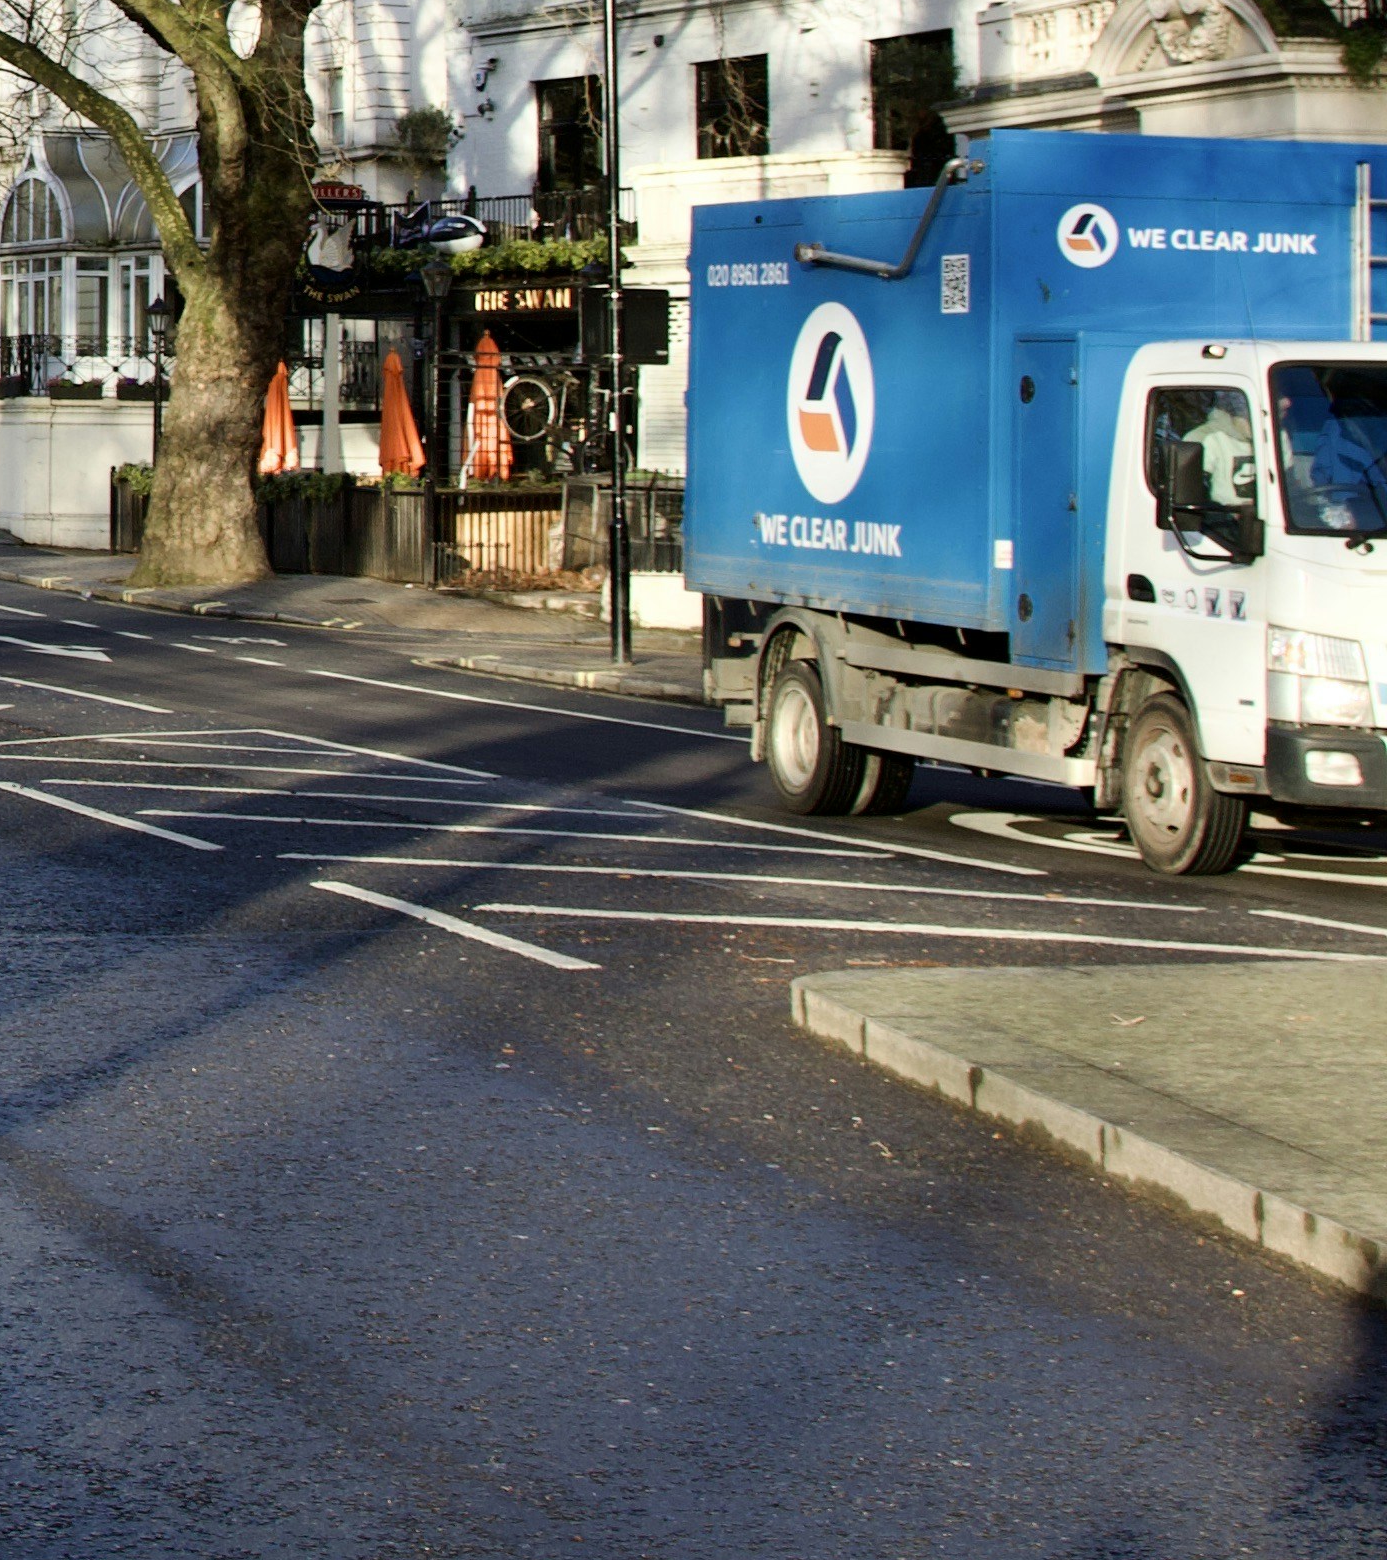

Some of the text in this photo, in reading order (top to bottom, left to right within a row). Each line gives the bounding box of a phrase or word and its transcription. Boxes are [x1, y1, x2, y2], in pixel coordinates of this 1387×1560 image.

[1127, 227, 1318, 255] WE CLEAR JUNK
[707, 264, 729, 287] 020
[514, 288, 572, 309] SWAN
[759, 512, 903, 558] WE CLEAR JUNK
